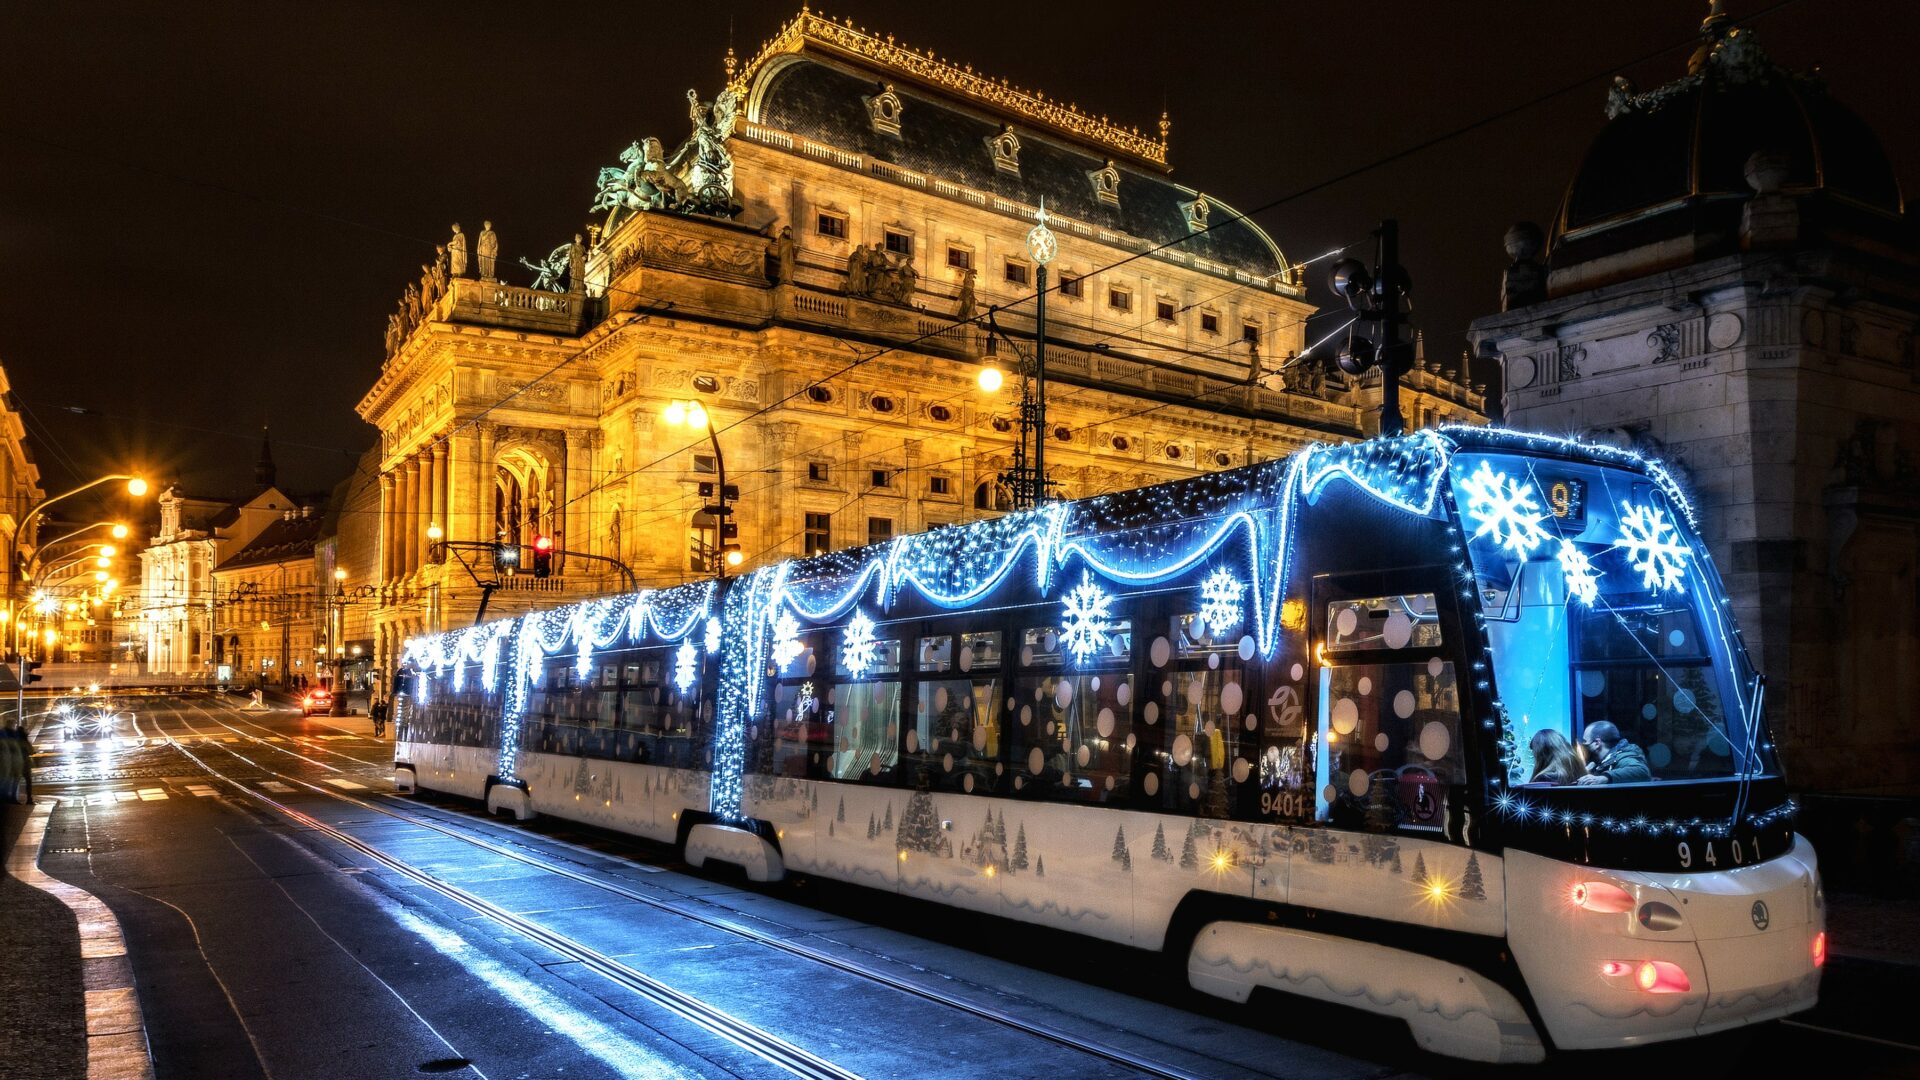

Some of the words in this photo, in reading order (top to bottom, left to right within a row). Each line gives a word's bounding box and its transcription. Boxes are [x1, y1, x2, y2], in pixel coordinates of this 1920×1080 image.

[1552, 483, 1568, 517] 9
[1261, 792, 1304, 817] 9401
[1678, 836, 1761, 868] 9401
